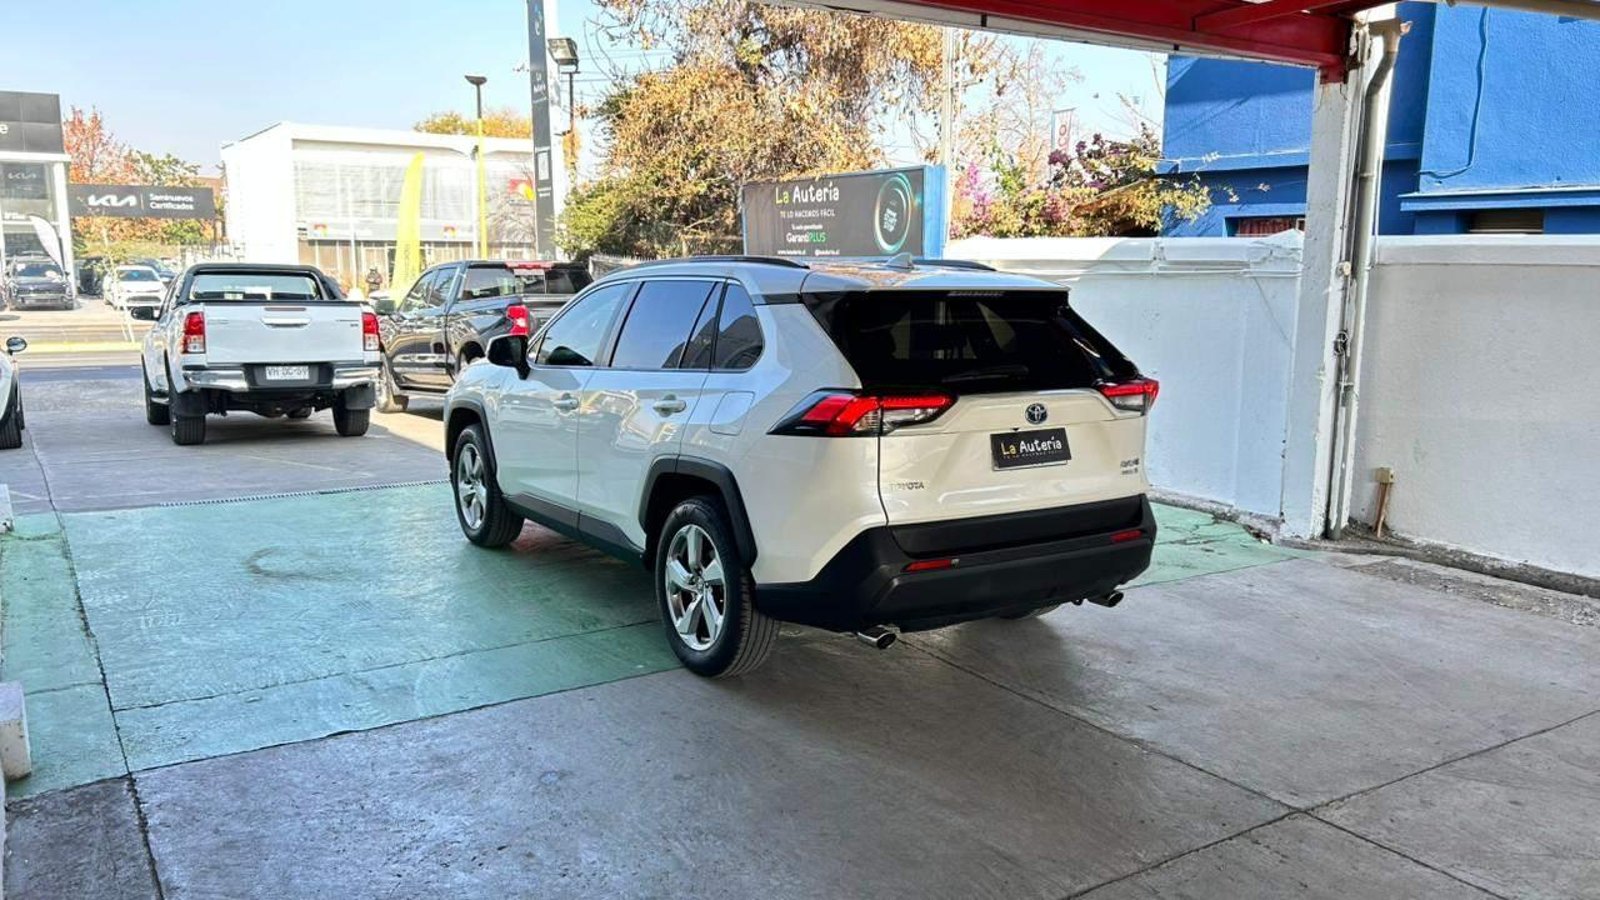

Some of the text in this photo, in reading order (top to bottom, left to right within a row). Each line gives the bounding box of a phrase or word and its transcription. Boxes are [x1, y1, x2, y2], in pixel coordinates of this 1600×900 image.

[149, 193, 194, 202] Seminuevos
[775, 181, 840, 204] La Autería
[88, 194, 137, 207] KIA
[149, 202, 195, 210] Certificados
[1001, 436, 1062, 455] La Autería
